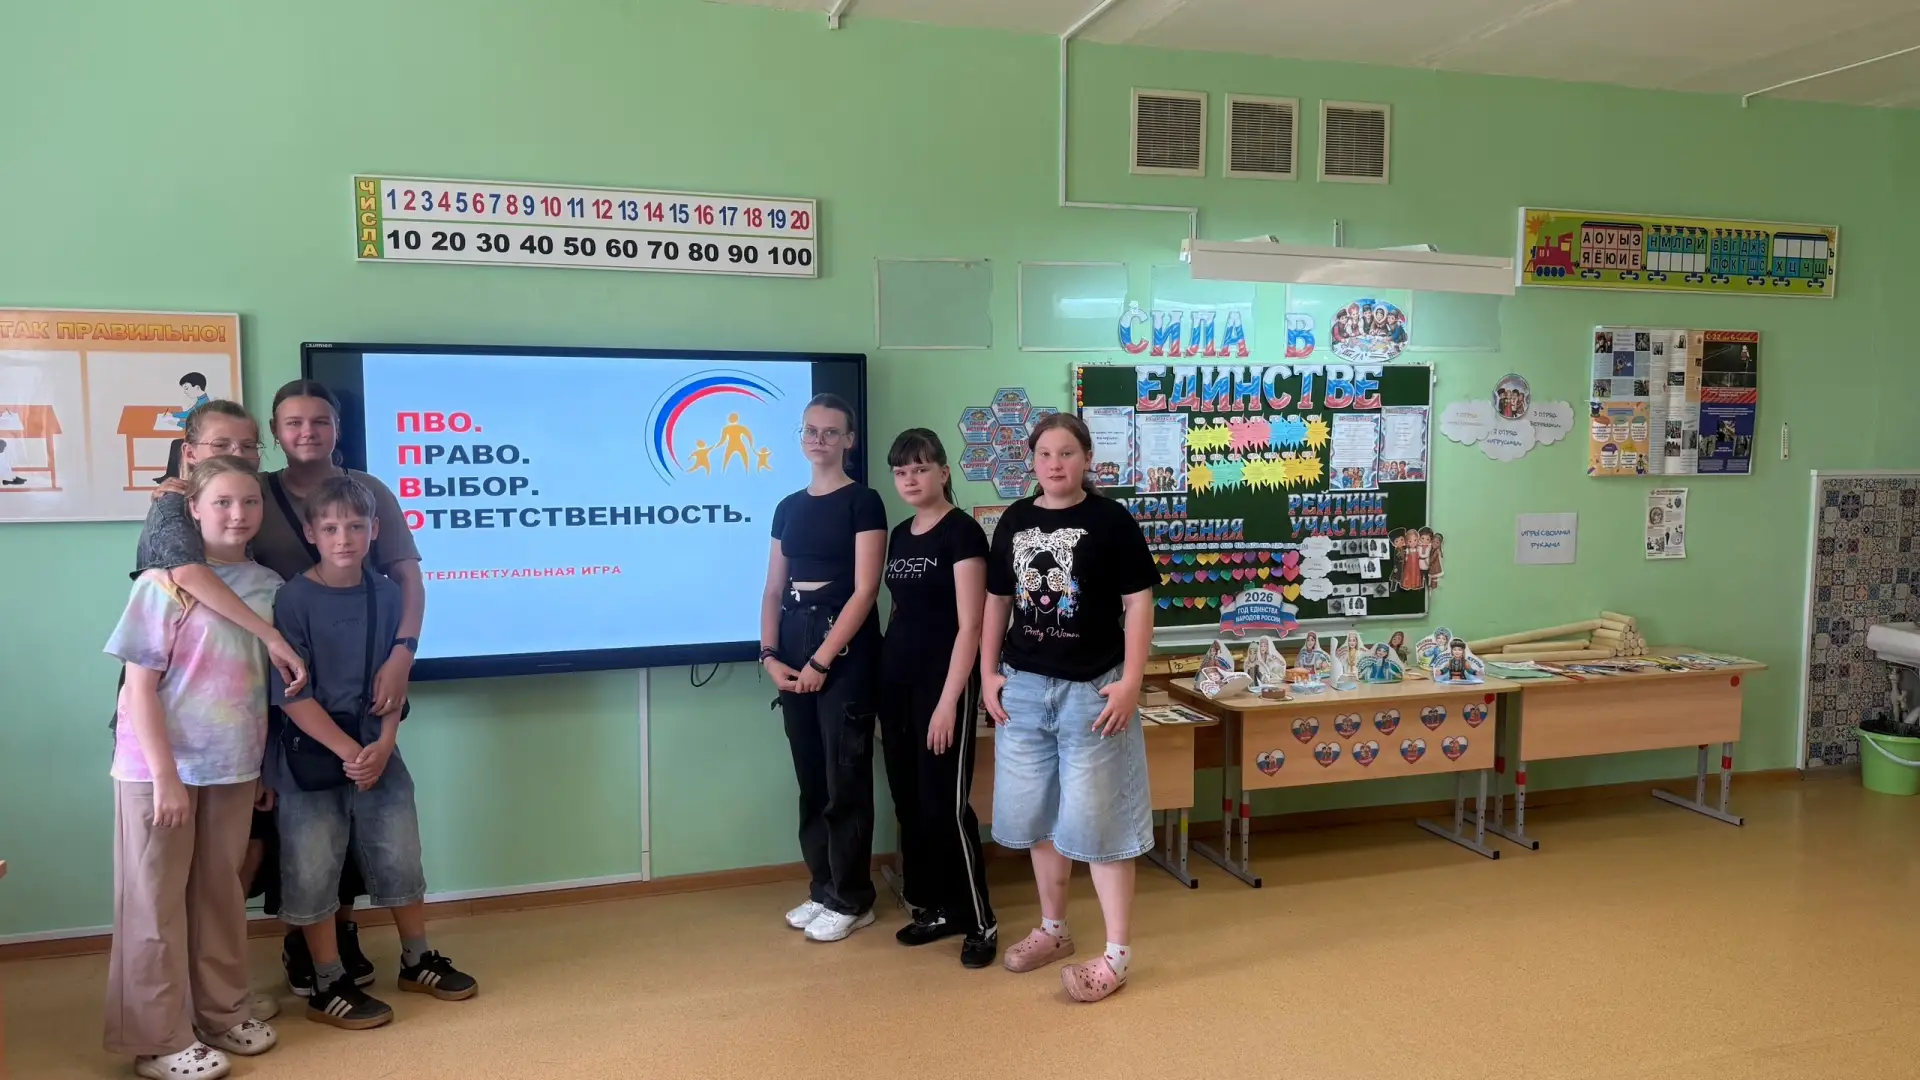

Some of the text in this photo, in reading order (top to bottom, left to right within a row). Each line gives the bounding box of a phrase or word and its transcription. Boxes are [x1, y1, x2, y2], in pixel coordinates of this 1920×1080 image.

[359, 180, 378, 258] ЧИСЛА
[387, 189, 810, 230] 1 2 3 4 5 6 7 8 9 10 11 12 13 14 15 16 17 18 19 20
[387, 230, 812, 266] 10 20 30 40 50 60 70 80 90 100
[1583, 232, 1640, 246] А О У Ы Э
[1582, 250, 1639, 265] Я Ё Ю И Е
[0, 320, 226, 342] ТАК ПРАВИЛЬНО!
[1118, 308, 1316, 358] СИЛА В
[1134, 365, 1384, 412] ЕДИНСТВЕ
[396, 411, 482, 433] ПВО.
[398, 444, 530, 466] ПРАВО.
[400, 476, 539, 498] ВЫБОР.
[1288, 490, 1388, 515] РЕЙТИНГ
[403, 504, 752, 530] ОТВЕТСТВЕННОСТЬ.
[1290, 514, 1388, 538] УЧАСТИЯ
[1139, 518, 1244, 543] ТРОЕНИЯ
[425, 565, 622, 581] ТЕЛЛЕКТУАЛЬНАЯ ИГРА
[1245, 592, 1273, 602] 2026
[1046, 626, 1080, 638] Woman
